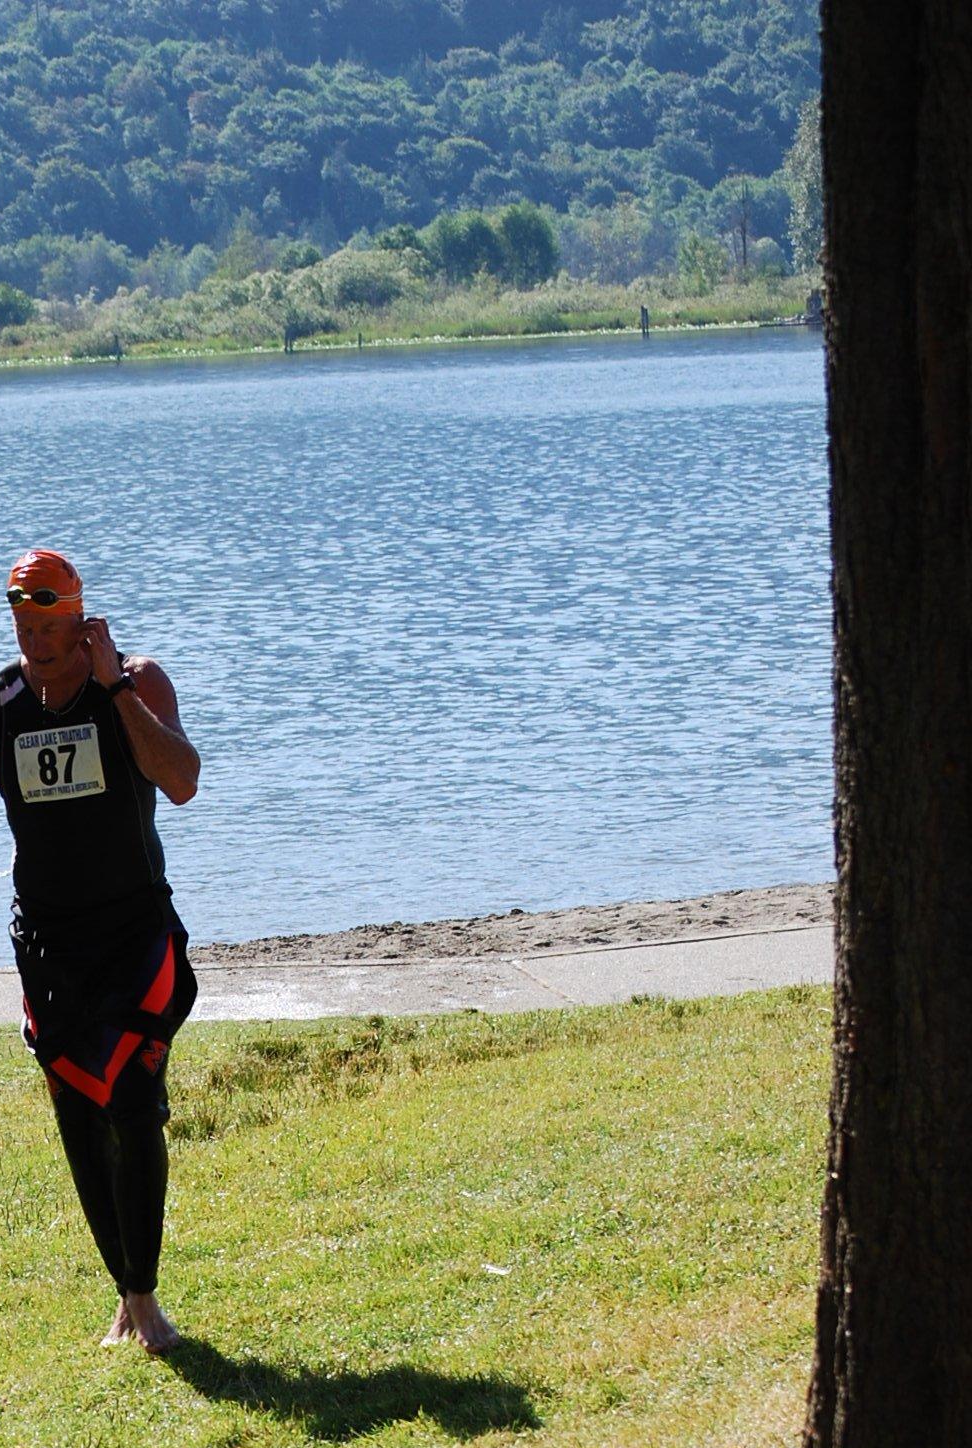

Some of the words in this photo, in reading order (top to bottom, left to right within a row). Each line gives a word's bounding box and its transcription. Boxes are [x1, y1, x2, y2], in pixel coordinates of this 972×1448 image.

[20, 734, 40, 749] CLEAR
[40, 732, 57, 746] LAKE
[58, 727, 92, 743] TRIATHLON
[38, 744, 76, 786] 87
